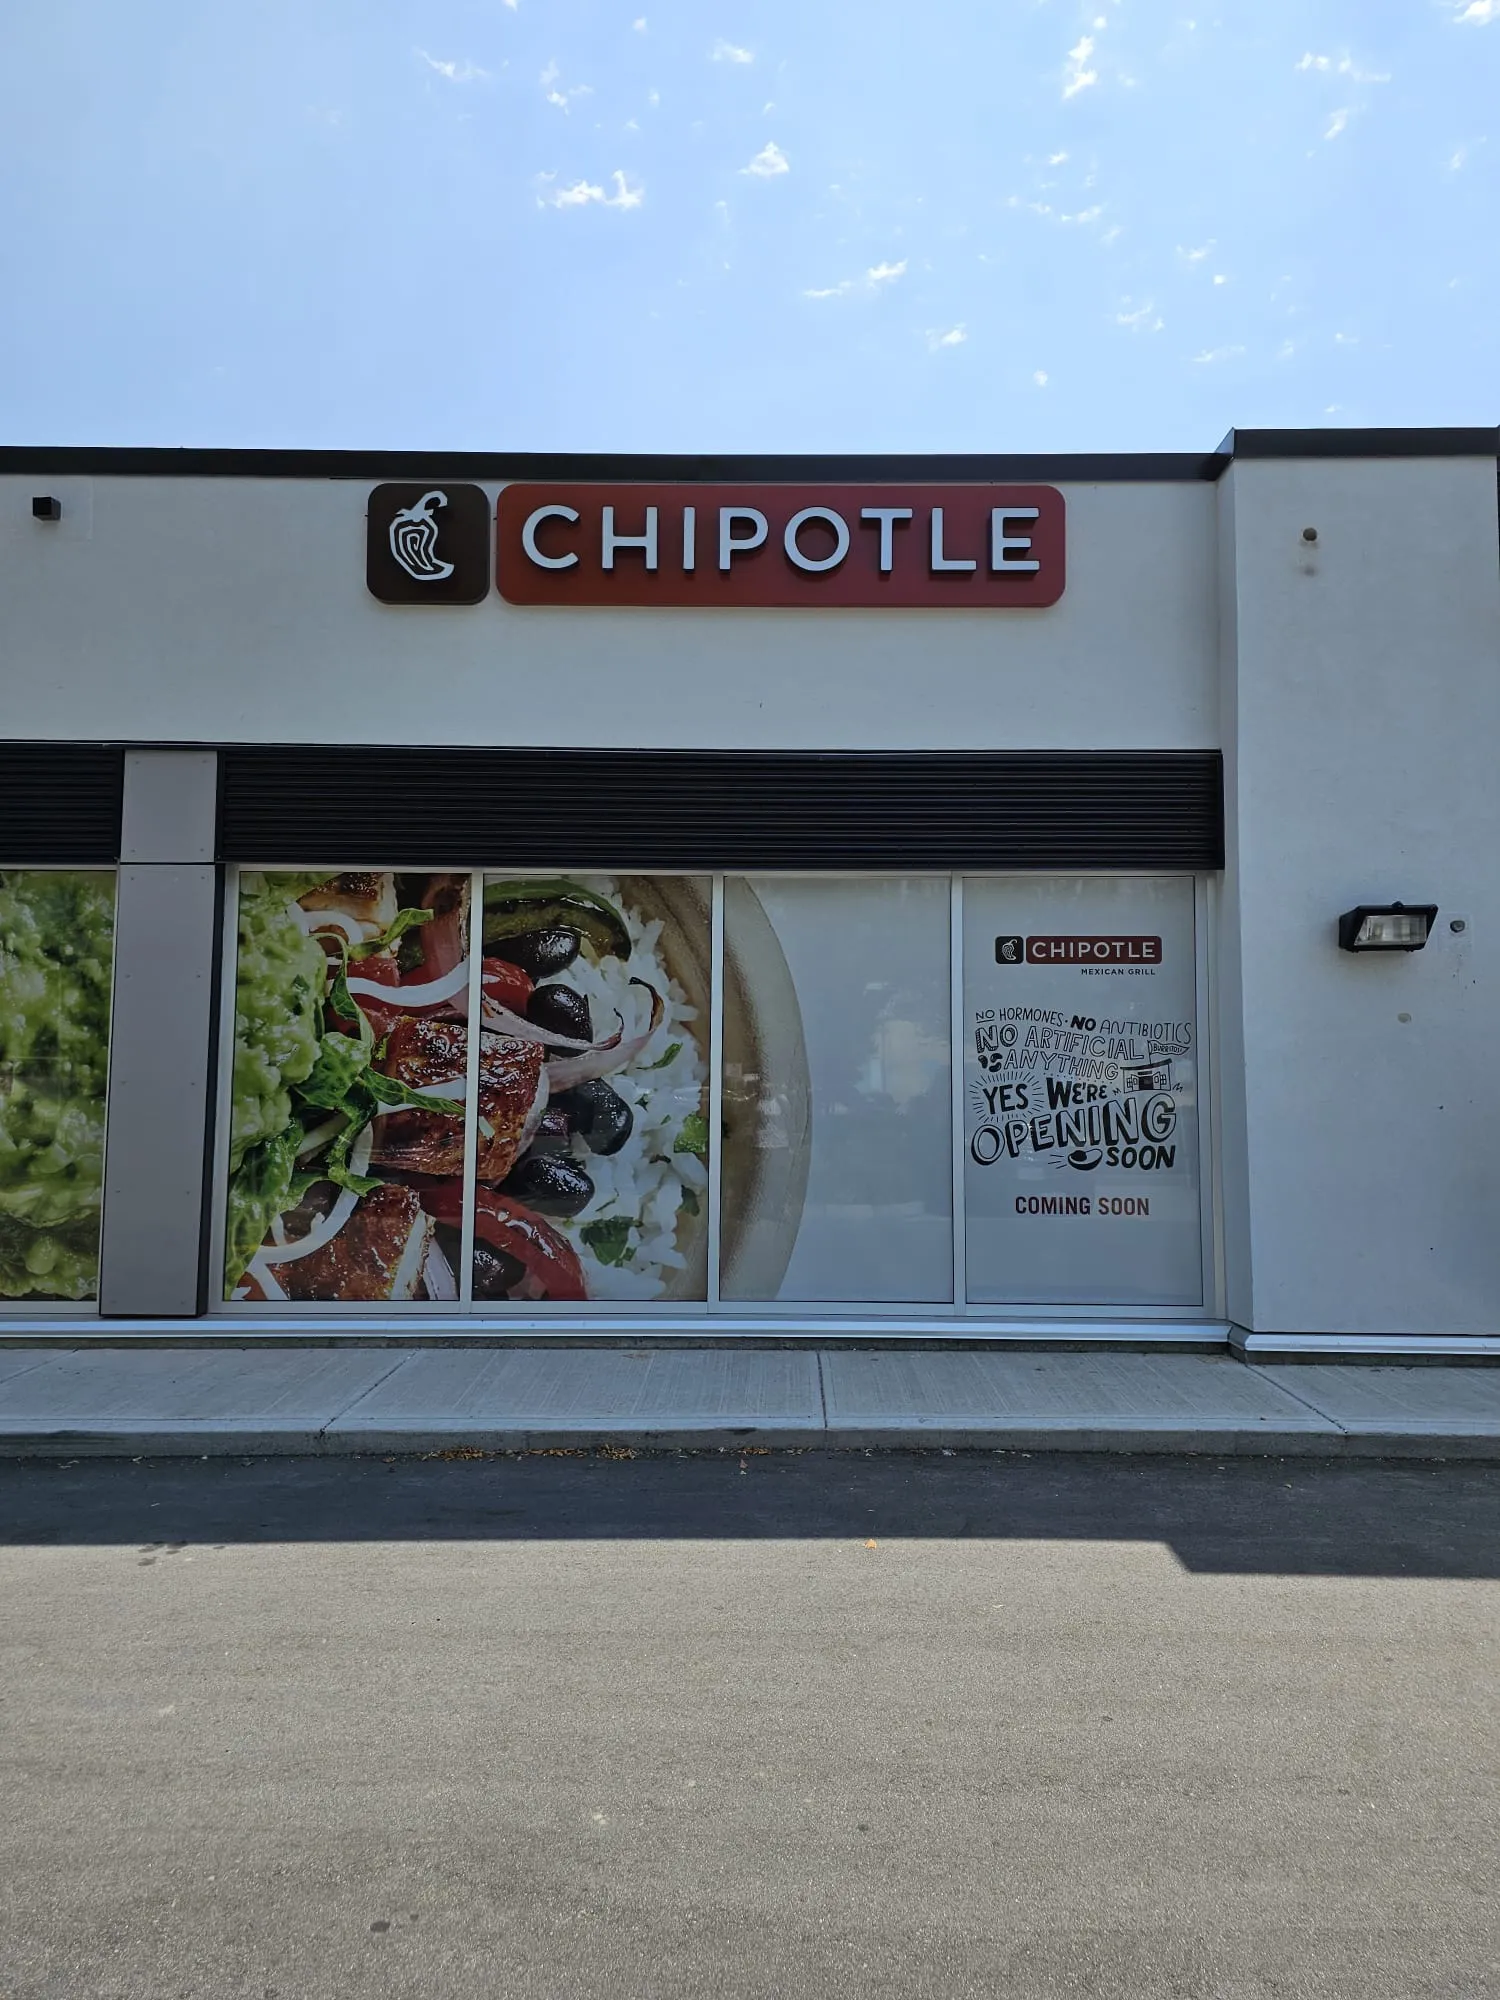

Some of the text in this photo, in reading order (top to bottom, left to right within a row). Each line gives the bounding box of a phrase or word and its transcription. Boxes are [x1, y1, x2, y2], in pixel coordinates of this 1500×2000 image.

[522, 505, 1040, 571] CHIPOTLE
[1032, 942, 1155, 958] CHIPOTLE
[976, 1007, 1192, 1044] NO HORMONES NO ANTIBIOTICS
[975, 1024, 1145, 1060] NO ARTIFICIAL
[1003, 1049, 1119, 1081] ANYTHING
[983, 1083, 1029, 1115] YES
[971, 1093, 1177, 1166] OPENING
[1106, 1145, 1176, 1170] SOON
[1015, 1196, 1150, 1216] COMING SOON
